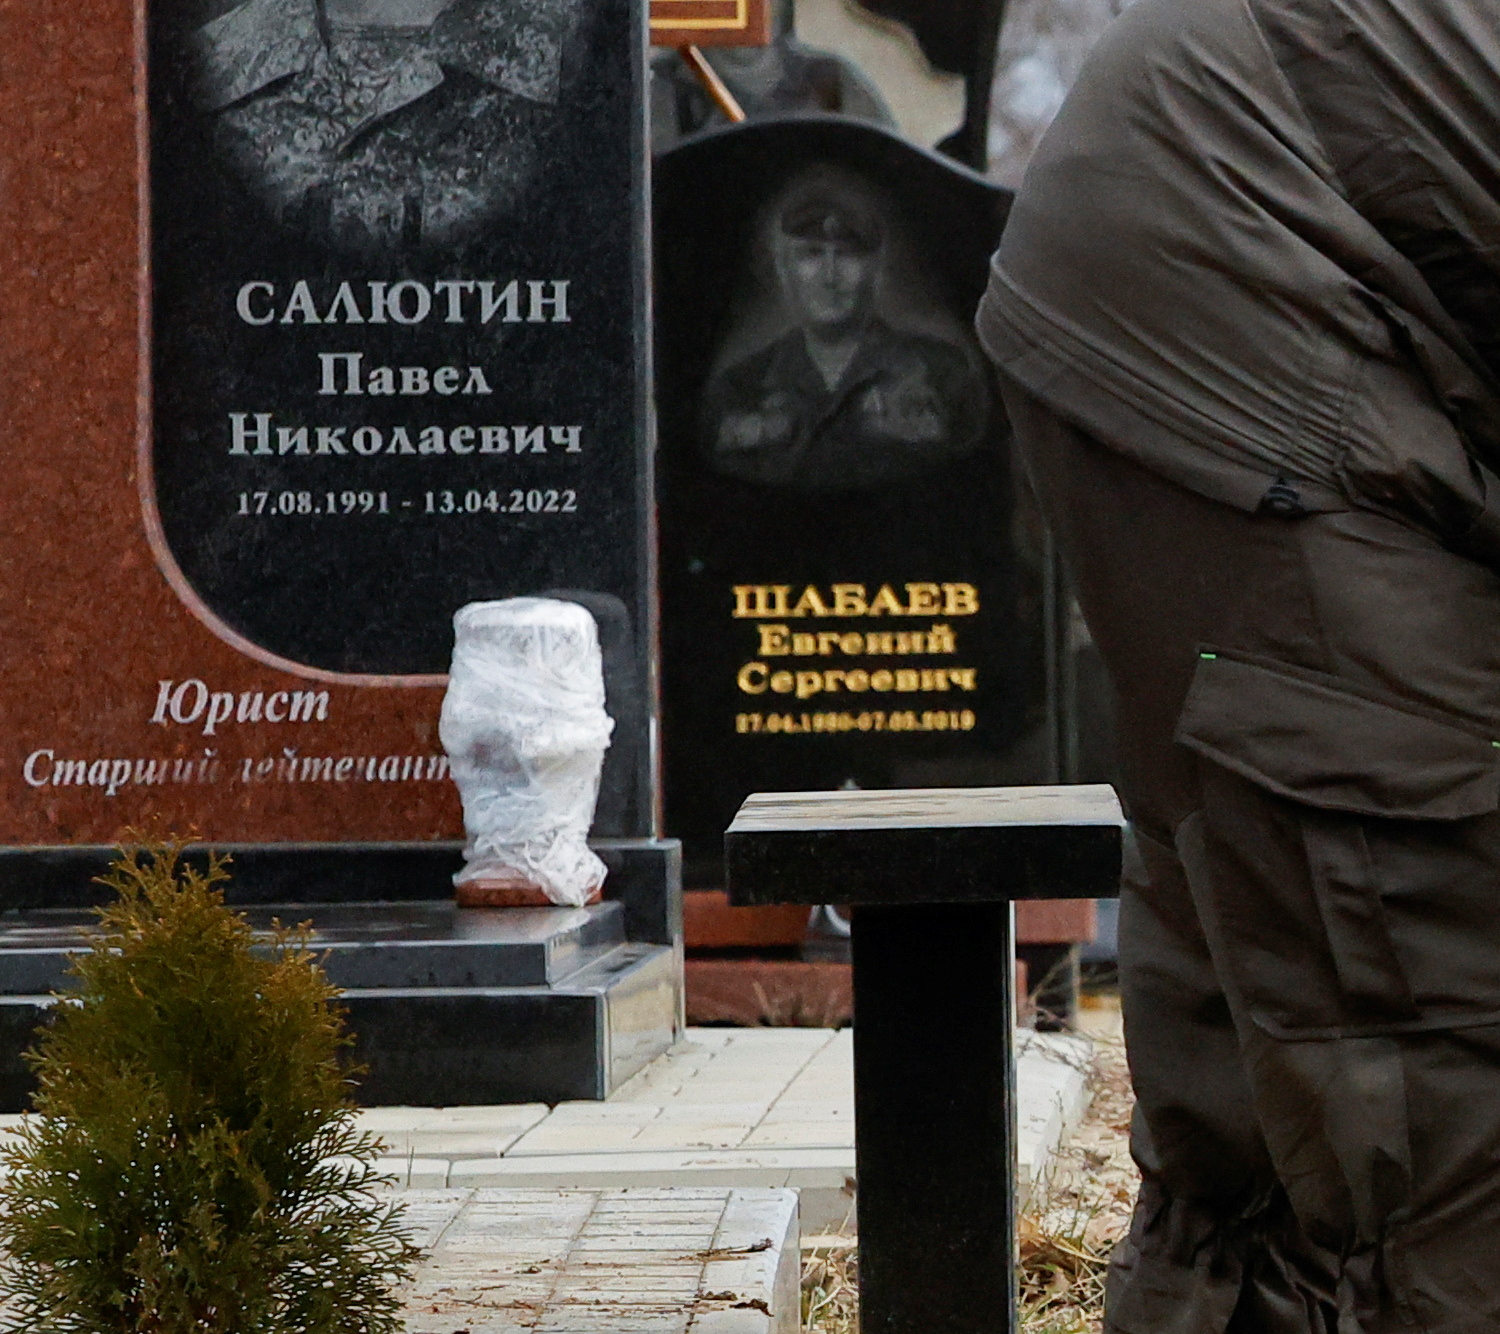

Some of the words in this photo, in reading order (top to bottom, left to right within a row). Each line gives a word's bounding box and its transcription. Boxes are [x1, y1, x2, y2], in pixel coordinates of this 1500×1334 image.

[236, 279, 572, 325] САЛЮТИН
[317, 352, 493, 396] Павел
[228, 412, 583, 456] Николаевич
[237, 491, 389, 515] 17.08.1991
[425, 489, 578, 514] 13.04.2022
[732, 582, 980, 618] ШАБАЕВ
[758, 623, 956, 656] Евгений
[737, 661, 976, 699] Сергеевич
[150, 679, 331, 730] Юрист
